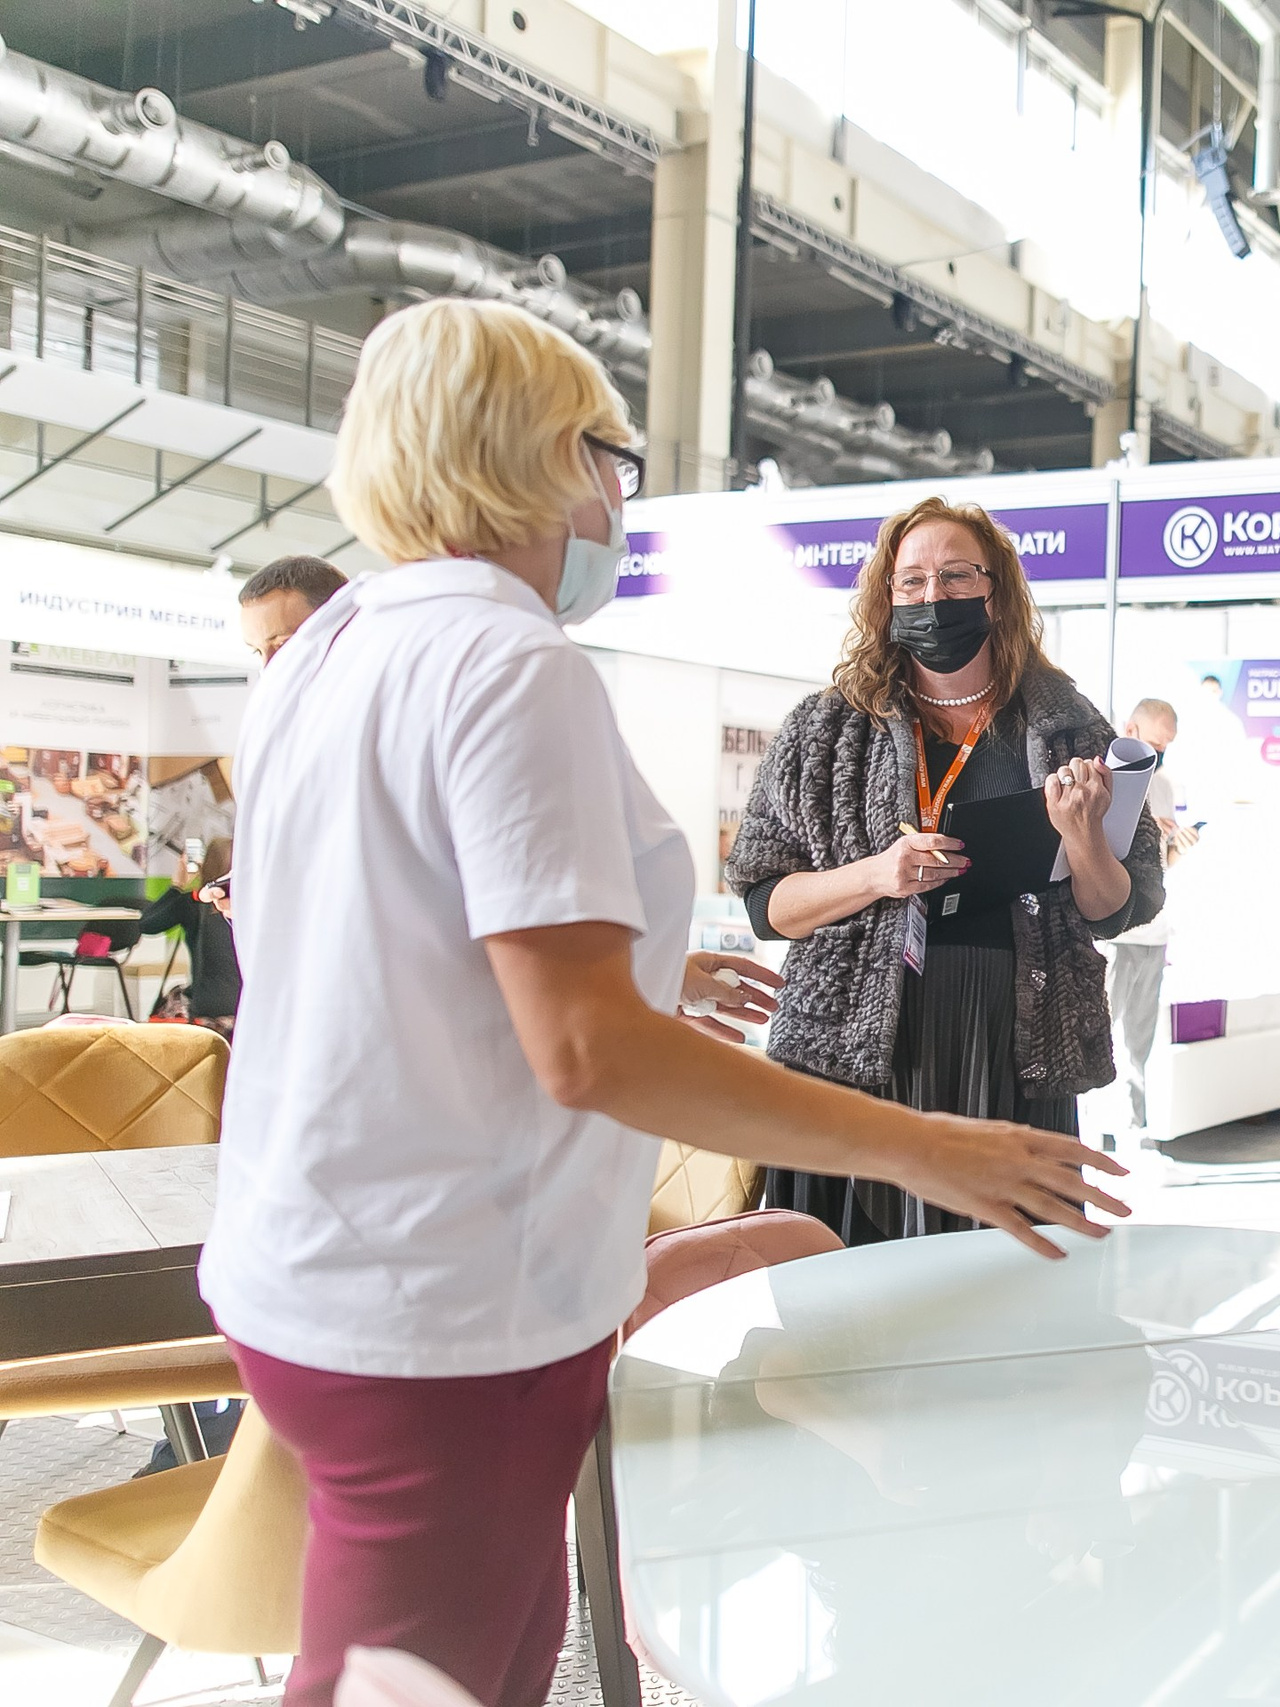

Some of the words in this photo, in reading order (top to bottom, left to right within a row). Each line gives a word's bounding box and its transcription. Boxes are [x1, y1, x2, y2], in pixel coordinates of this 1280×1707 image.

[1004, 530, 1066, 556] ВАТИ
[20, 591, 143, 619] ИНДУСТРИЯ
[149, 608, 226, 630] МЕБЕЛИ
